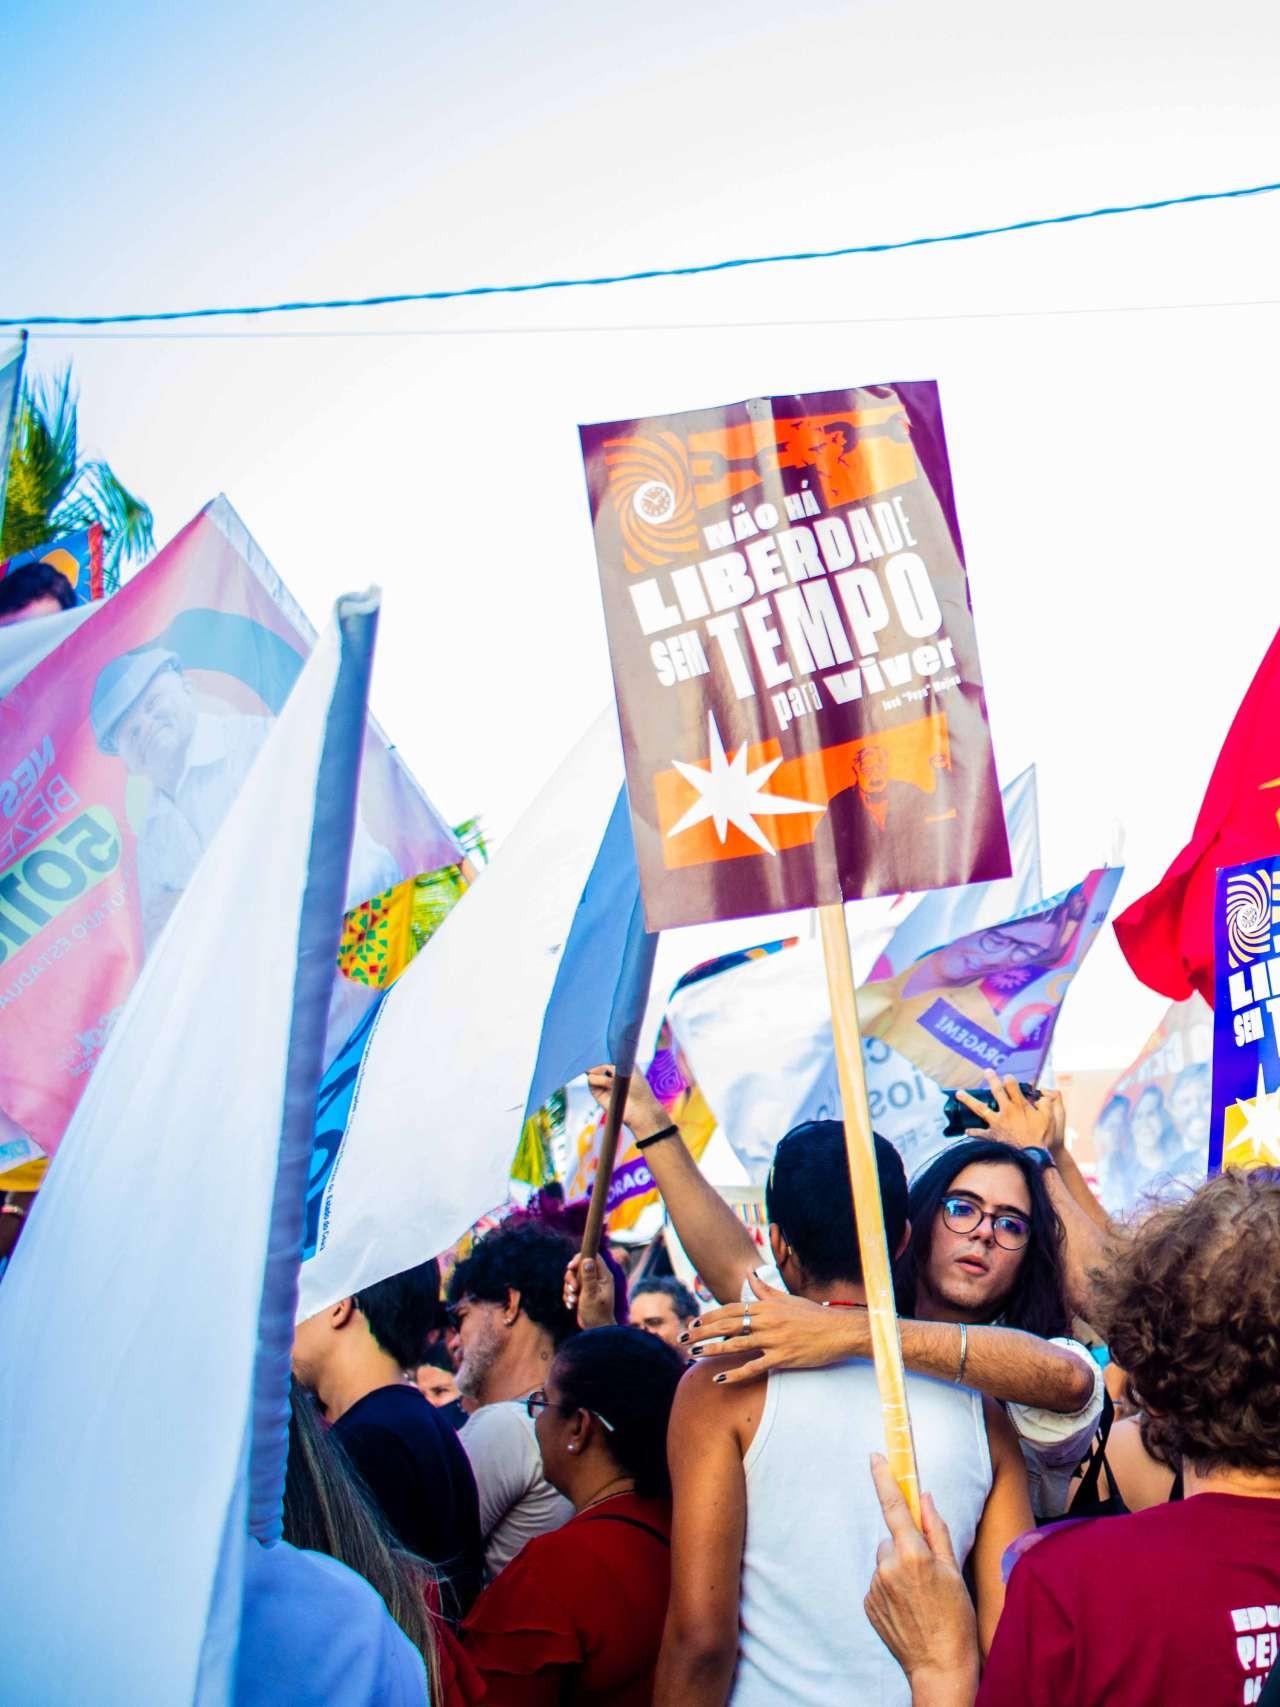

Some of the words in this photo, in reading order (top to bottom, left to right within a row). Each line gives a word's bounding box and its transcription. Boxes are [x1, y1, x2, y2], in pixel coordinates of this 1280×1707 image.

[703, 502, 779, 552] NÃO
[783, 479, 822, 522] HÁ
[628, 496, 917, 636] LIBERDADE
[649, 629, 710, 687] SEM
[705, 552, 943, 701] TEMPO
[771, 680, 823, 732] para
[823, 637, 957, 705] viver
[1233, 1007, 1265, 1048] SEM
[607, 1166, 652, 1204] ORAG
